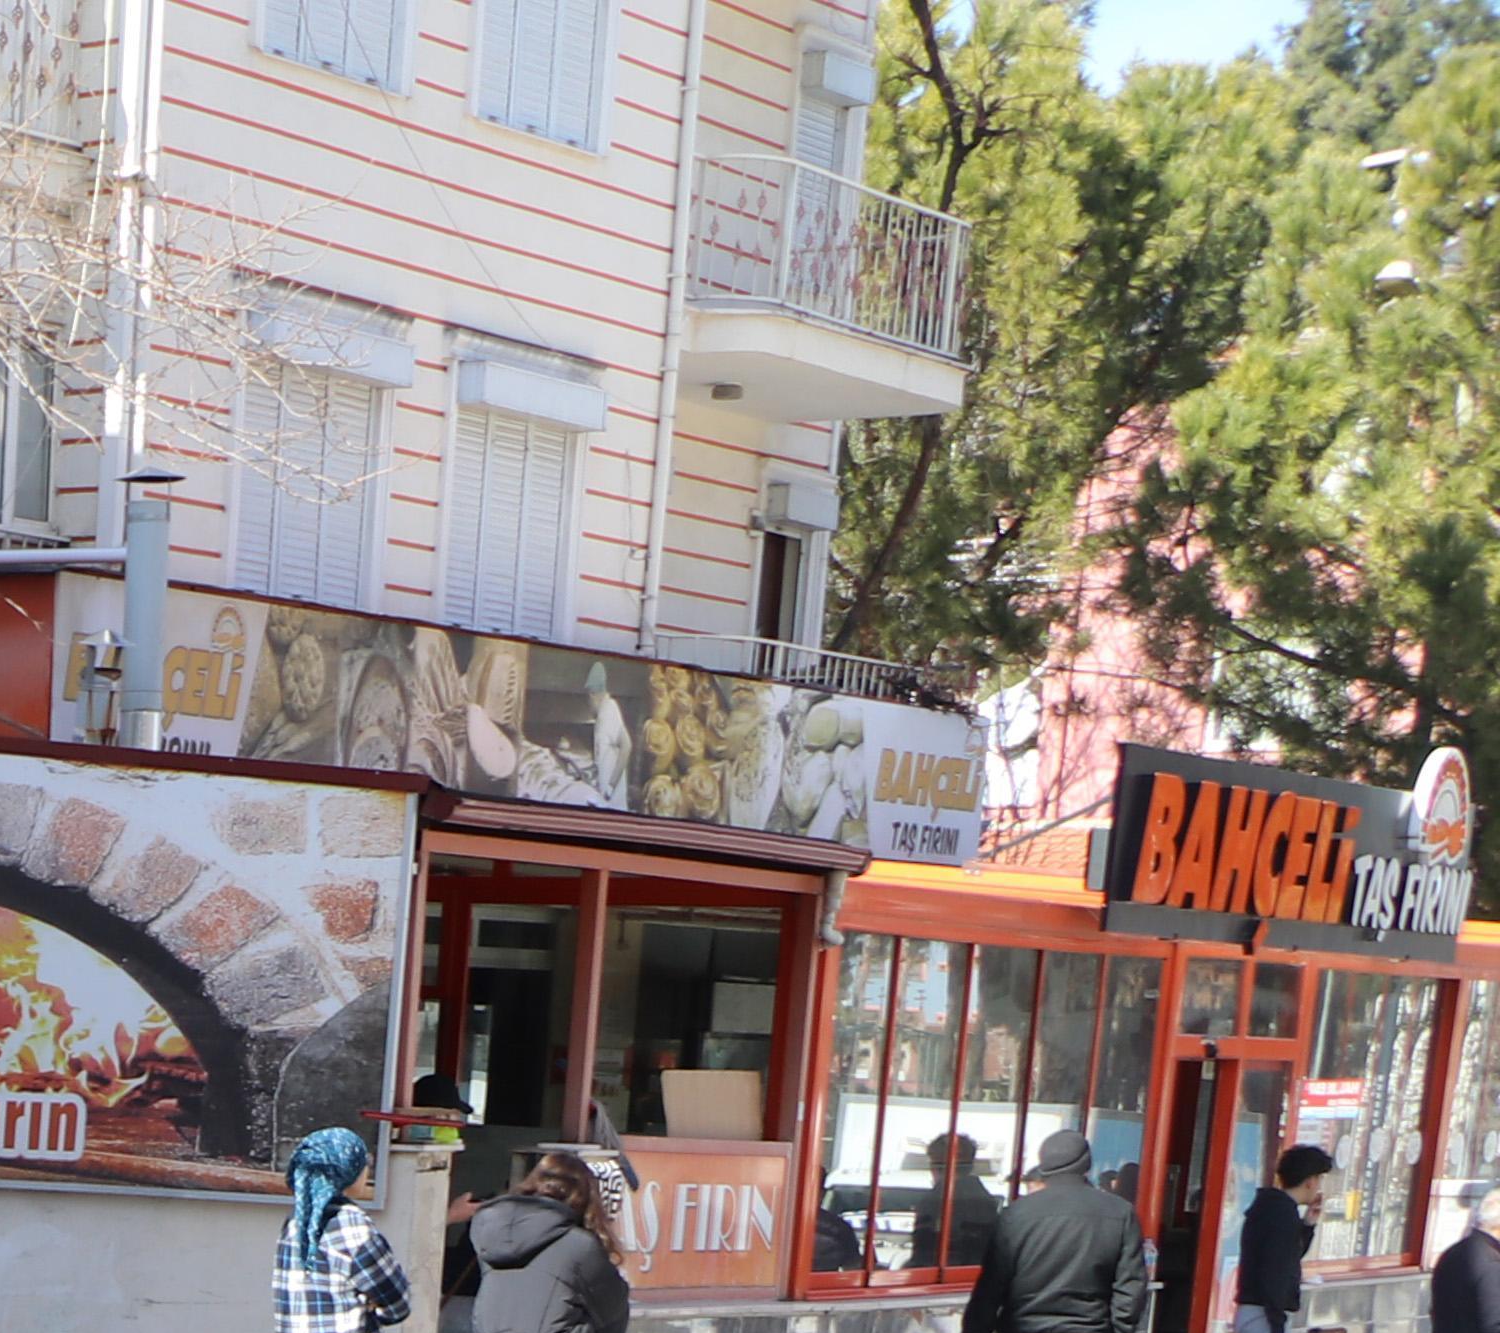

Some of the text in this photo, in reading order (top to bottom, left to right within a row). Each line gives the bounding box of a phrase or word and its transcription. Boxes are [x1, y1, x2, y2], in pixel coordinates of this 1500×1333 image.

[891, 820, 918, 858] TAŞ
[1351, 853, 1474, 943] TAŞ FIRINI
[618, 1180, 780, 1273] AŞ FIRIN
